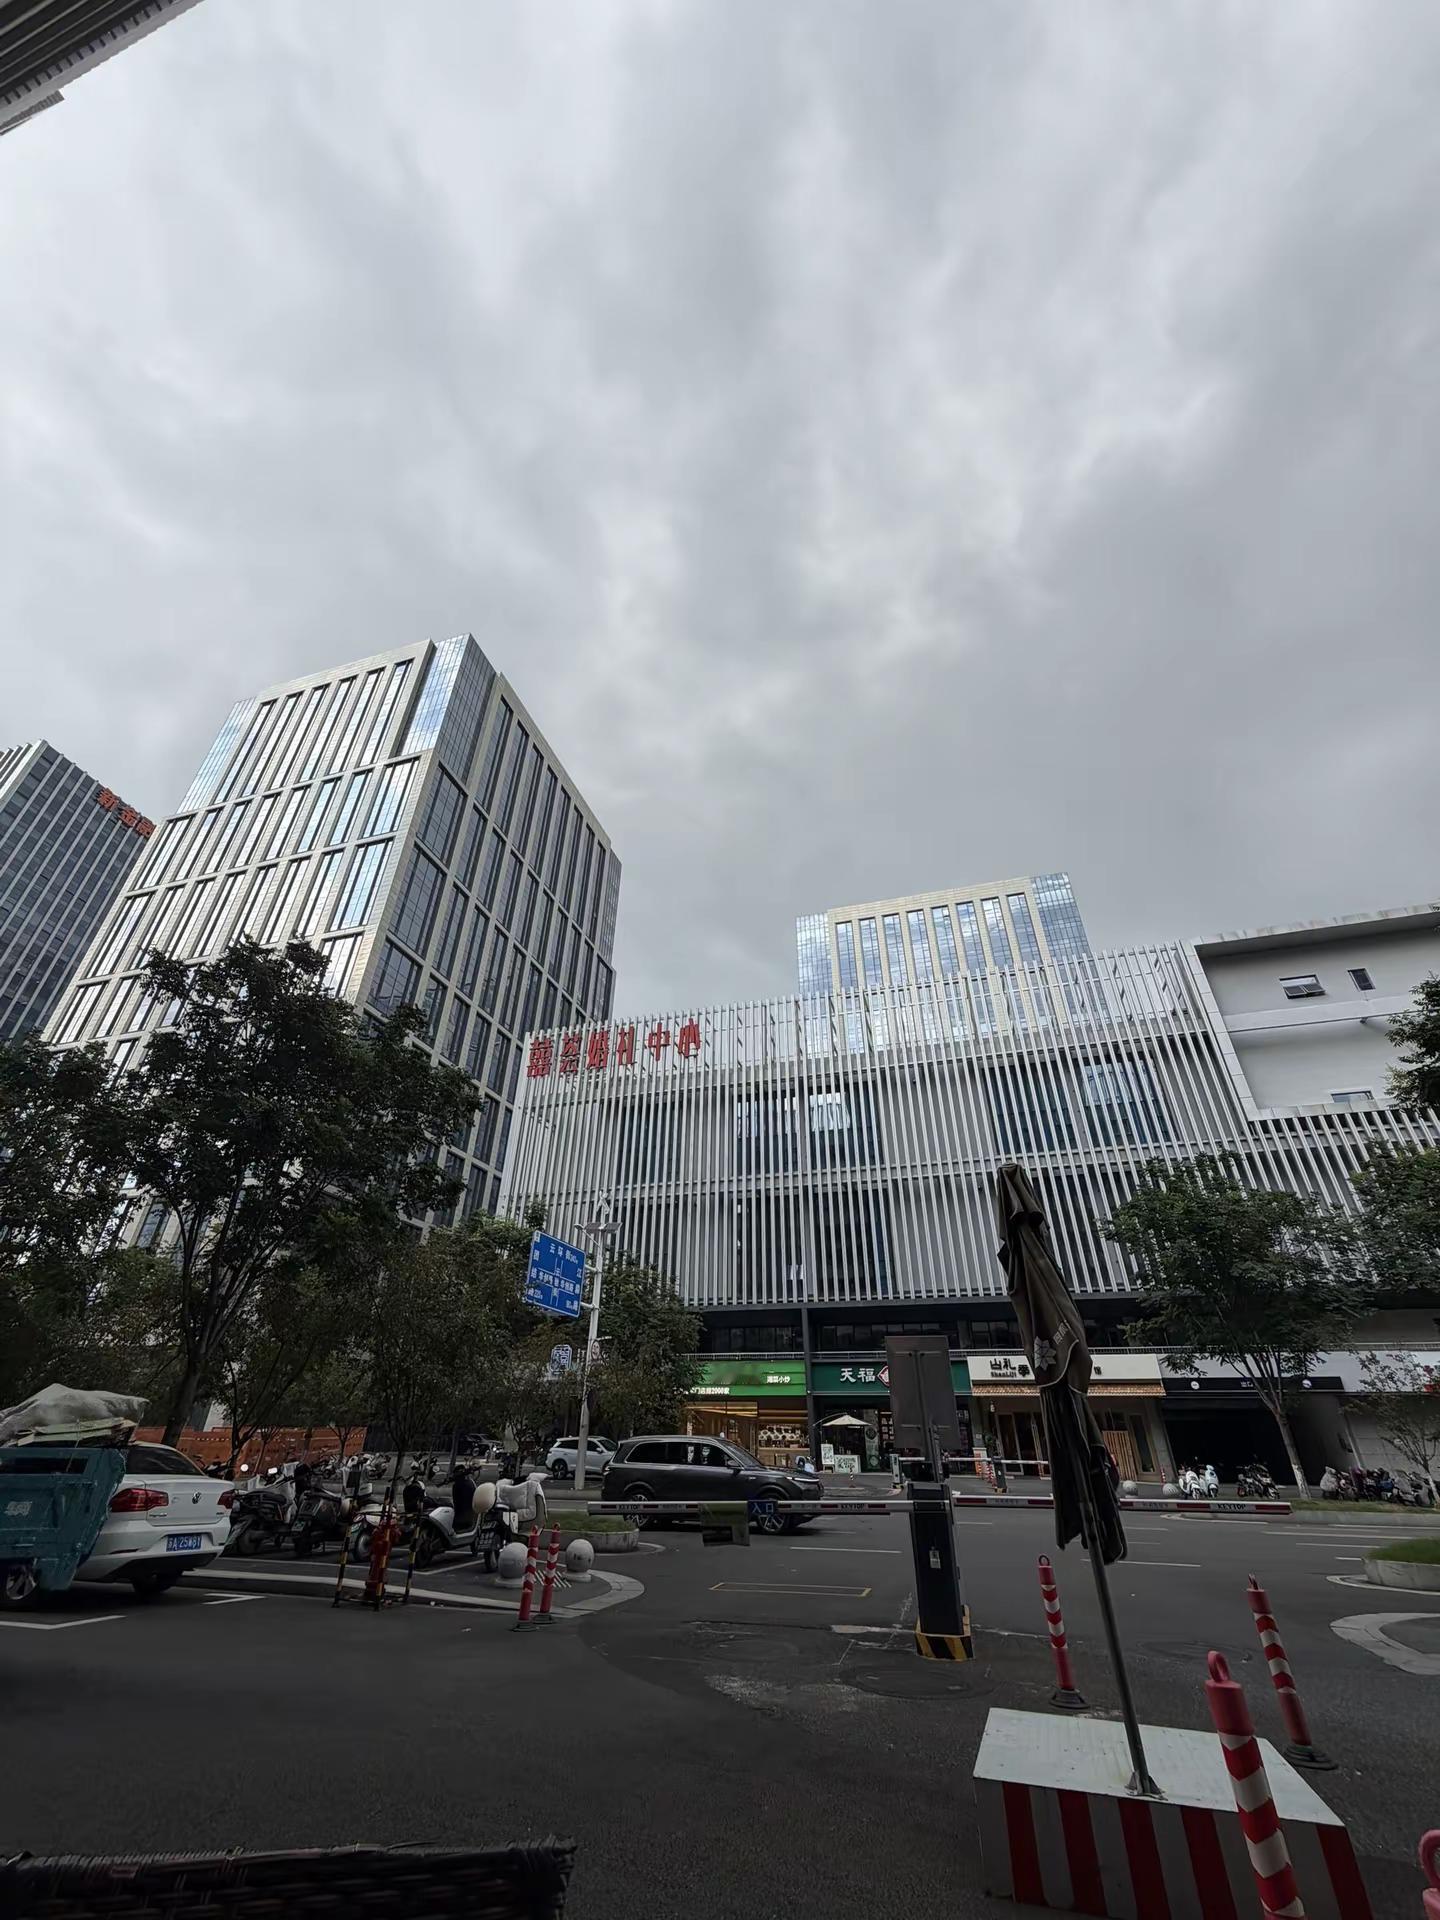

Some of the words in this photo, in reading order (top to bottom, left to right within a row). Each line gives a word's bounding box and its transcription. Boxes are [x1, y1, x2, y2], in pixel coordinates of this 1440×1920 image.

[840, 1368, 876, 1383] 天福
[752, 1503, 774, 1514] 入口
[1217, 1503, 1246, 1511] KEYTOP
